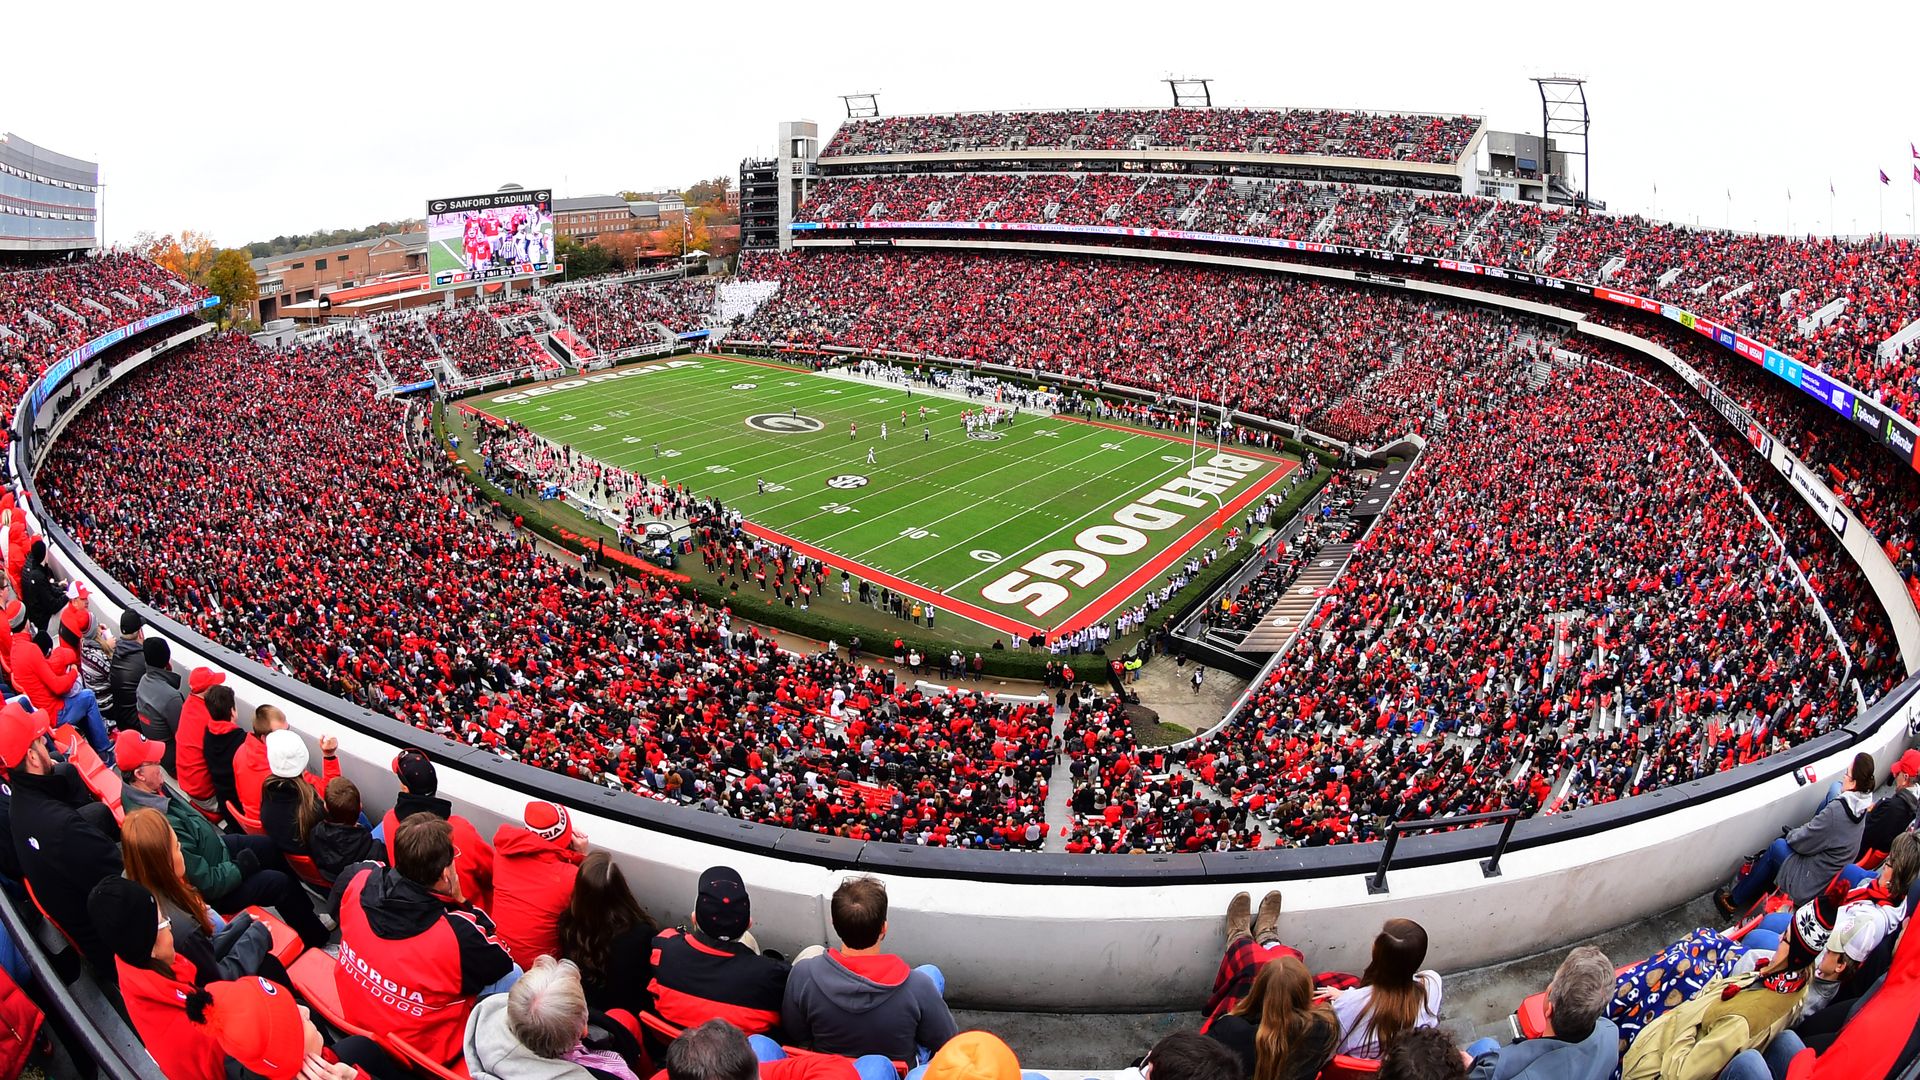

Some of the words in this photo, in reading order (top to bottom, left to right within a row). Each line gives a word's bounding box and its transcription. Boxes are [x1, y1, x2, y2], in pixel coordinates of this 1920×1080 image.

[450, 198, 490, 210] SANFORD
[494, 194, 532, 205] STADIUM
[491, 359, 700, 403] GEORGIA
[819, 502, 851, 514] 20
[899, 527, 929, 539] 10
[980, 453, 1265, 618] BULLDOGS
[339, 955, 424, 1017] BULLDOGS
[342, 939, 425, 1004] GEORGIA
